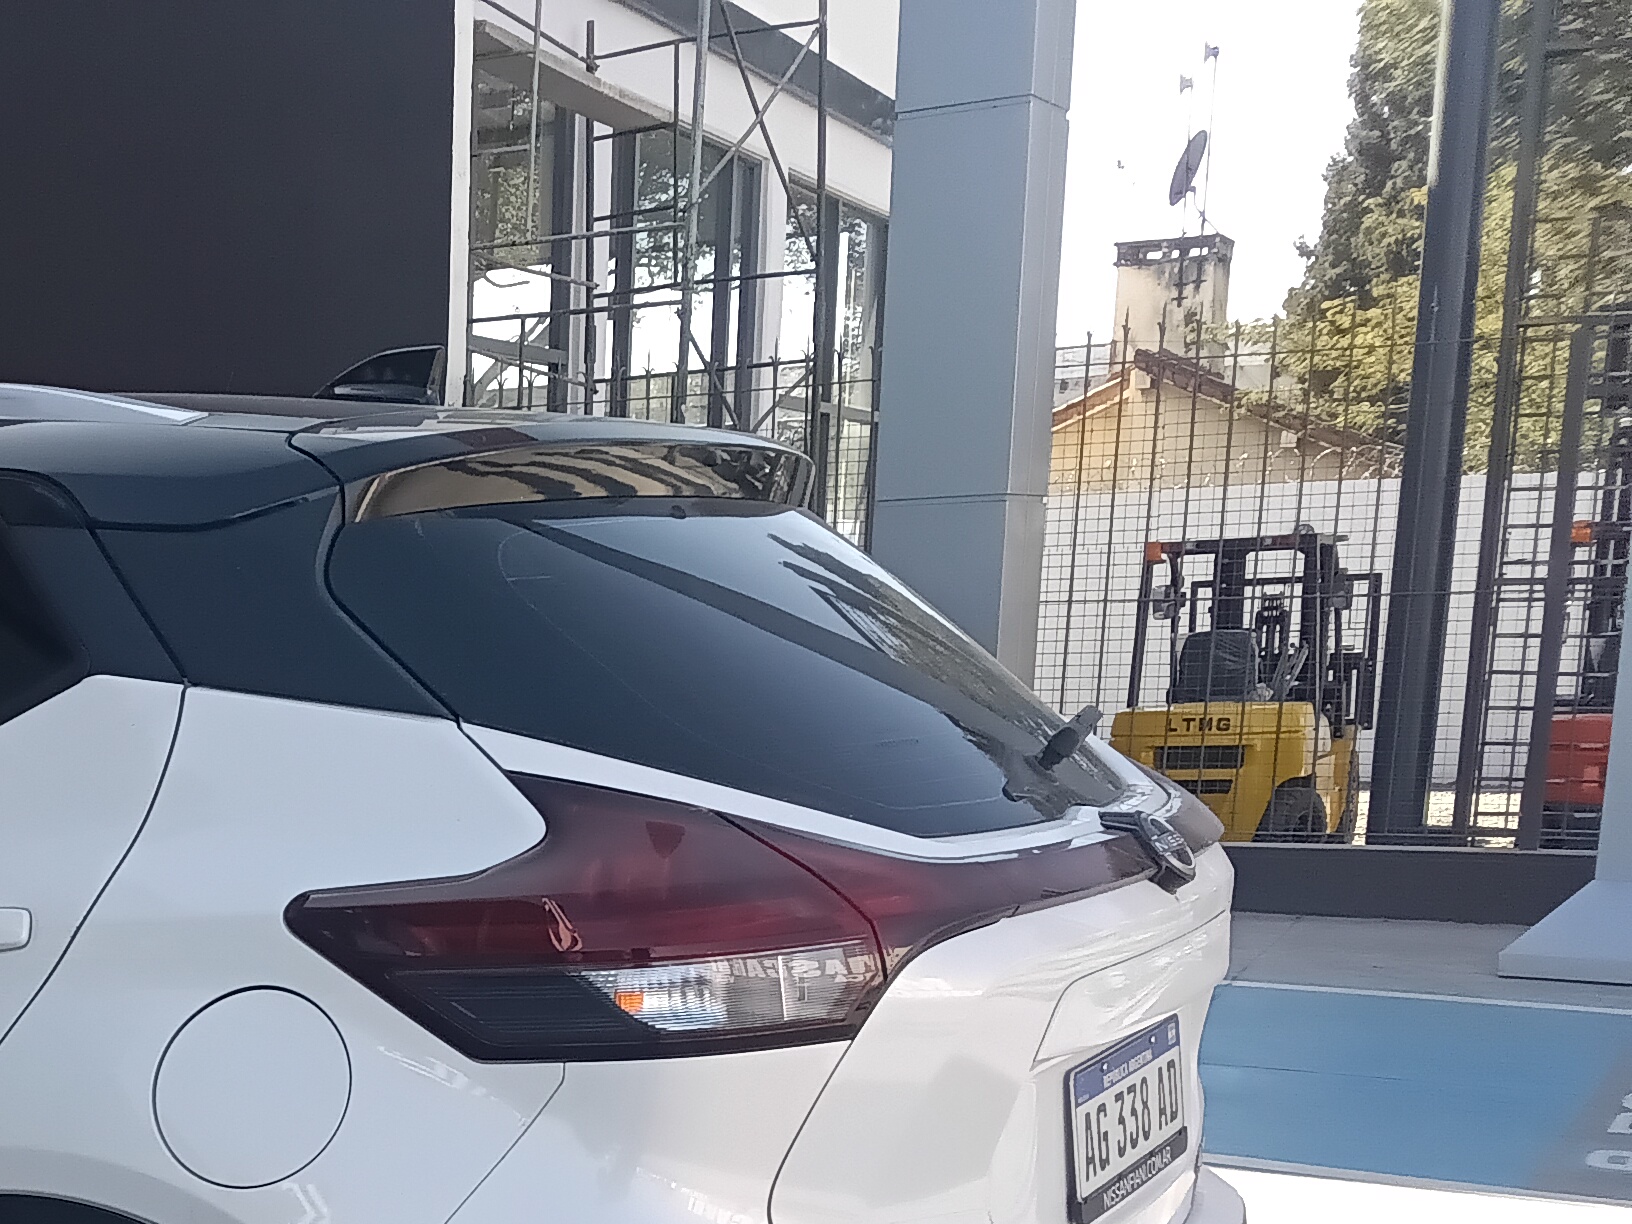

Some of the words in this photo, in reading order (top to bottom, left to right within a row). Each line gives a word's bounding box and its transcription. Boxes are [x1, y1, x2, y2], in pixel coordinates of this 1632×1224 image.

[1084, 1102, 1110, 1182] AG
[1114, 1076, 1152, 1159] 338
[1157, 1058, 1179, 1131] AD
